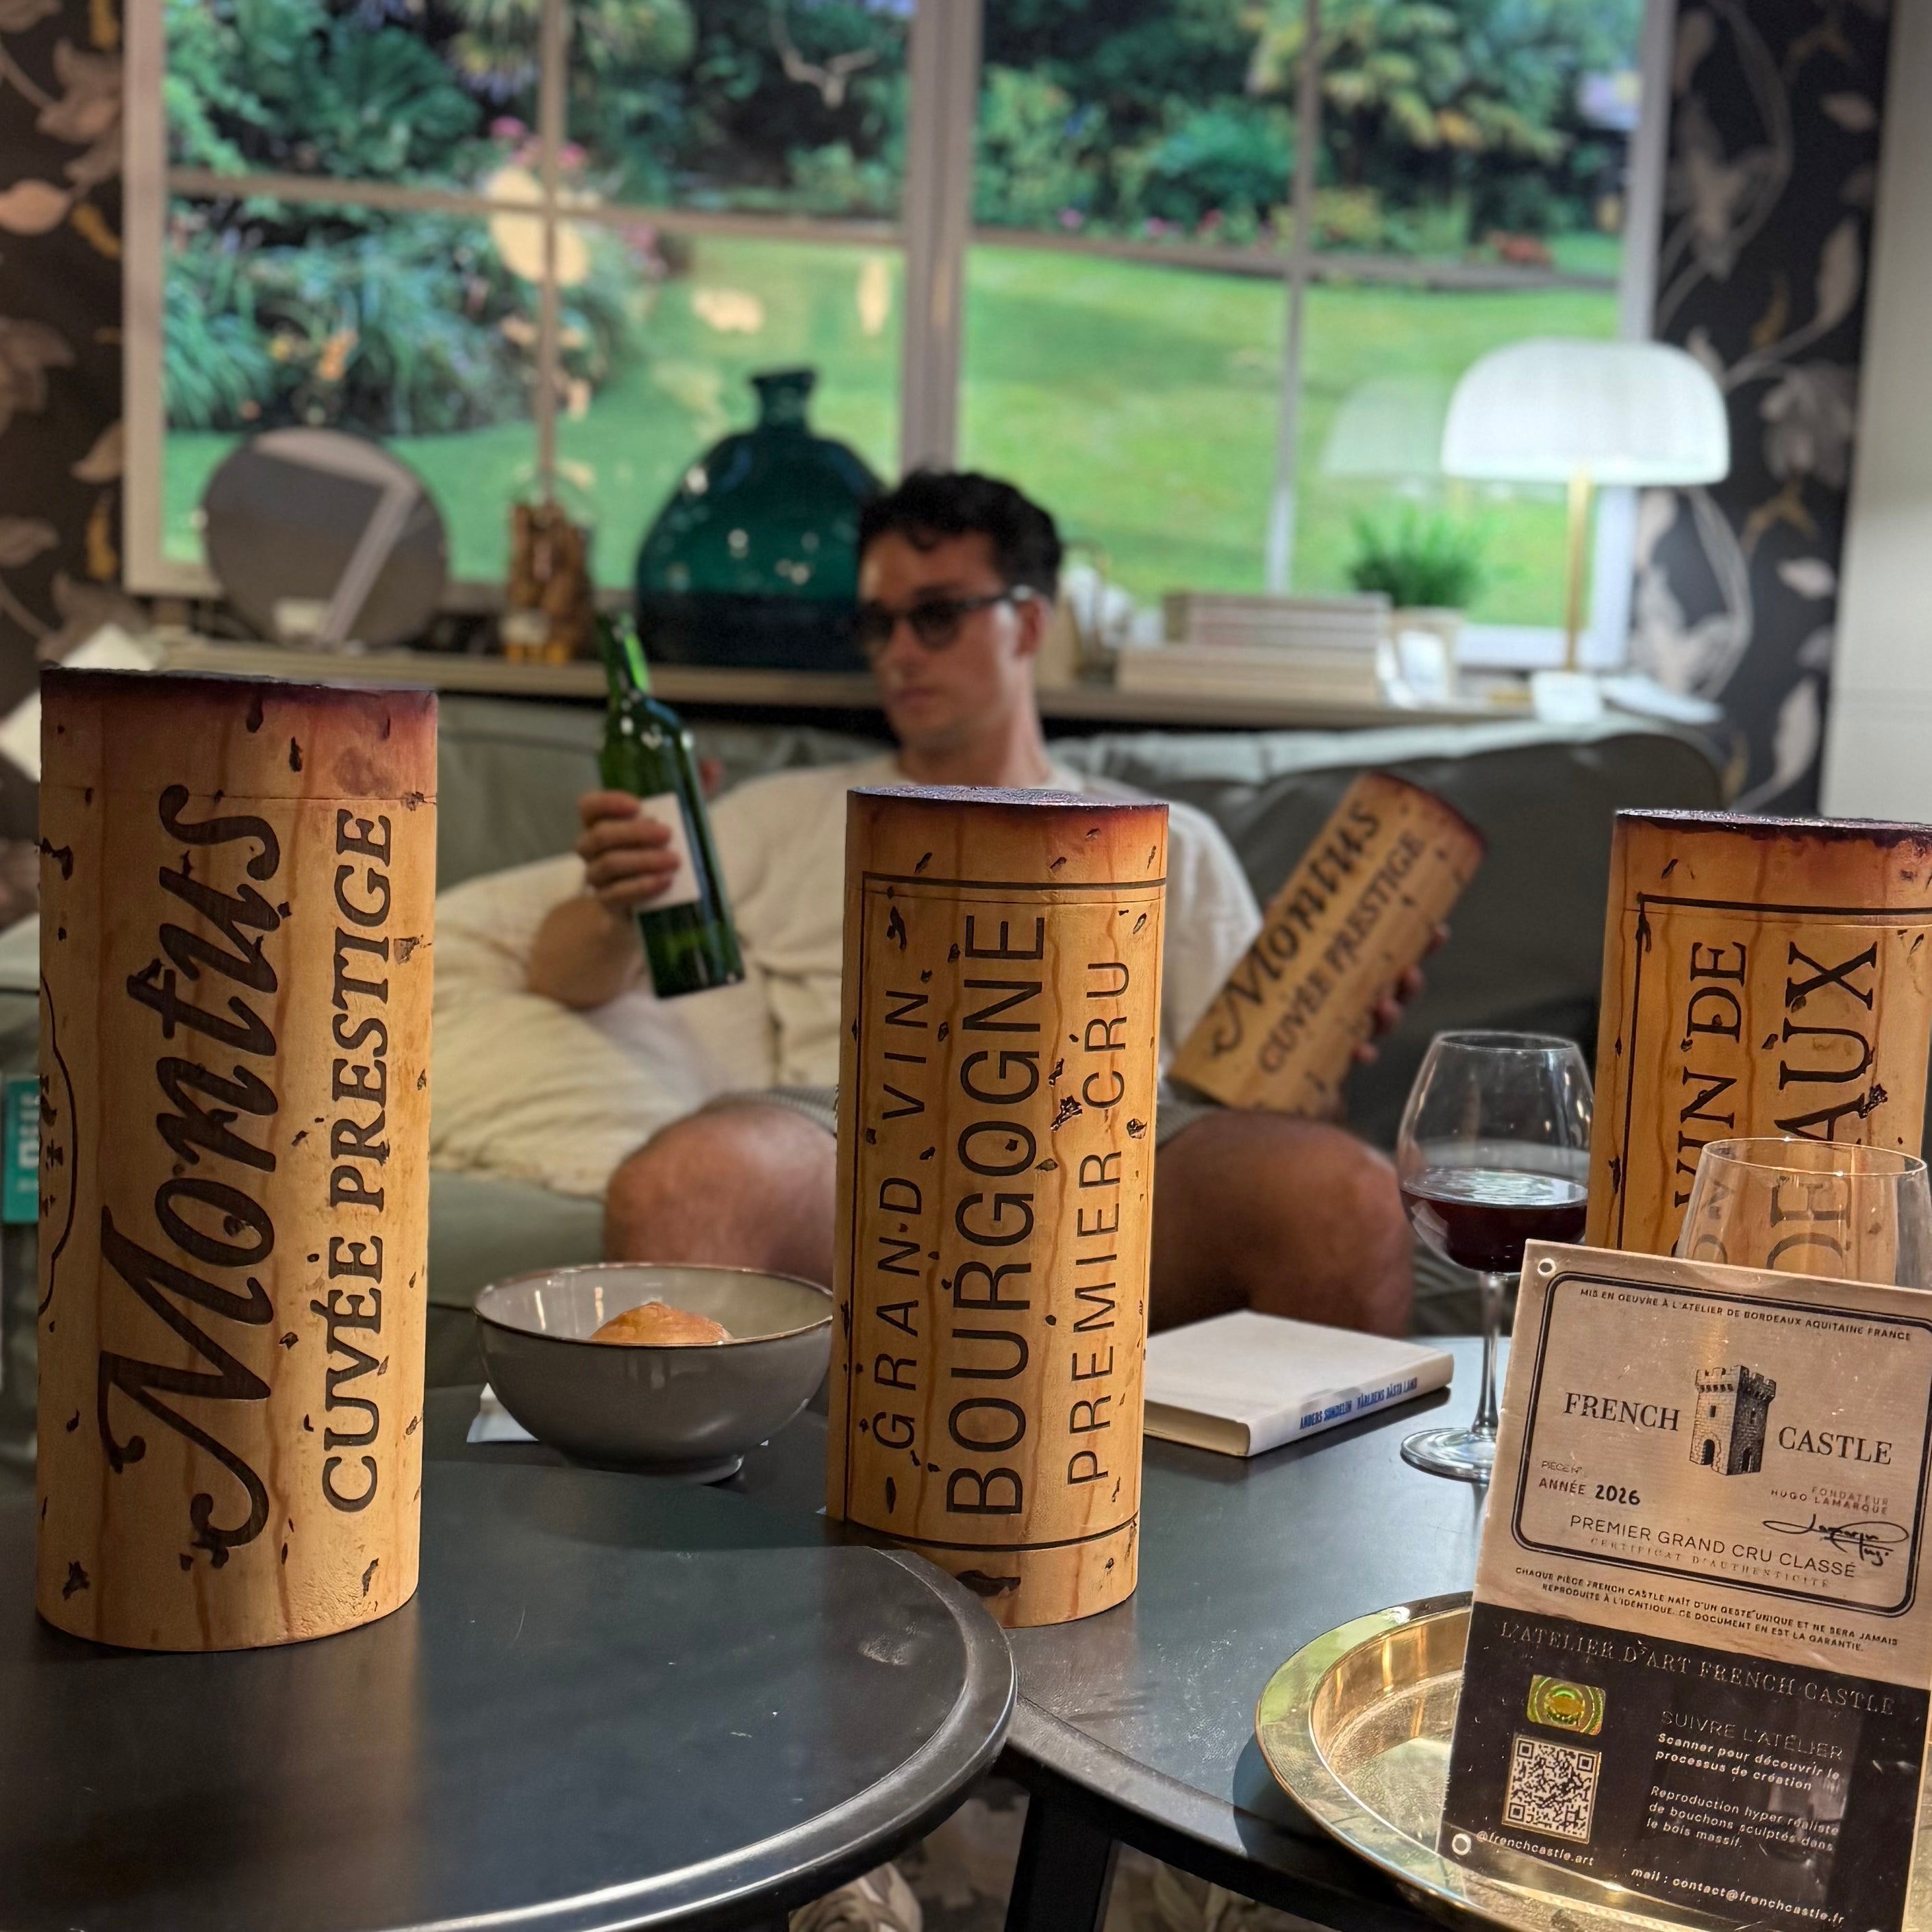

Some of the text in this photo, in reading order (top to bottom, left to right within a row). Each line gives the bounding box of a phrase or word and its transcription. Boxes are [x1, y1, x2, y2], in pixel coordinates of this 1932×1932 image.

[1686, 941, 1746, 1042] DE
[97, 785, 280, 1551] Montus
[310, 808, 392, 1512] CUVÉE PRESTIGE
[872, 991, 929, 1450] GRAND VIN
[946, 915, 1045, 1515] BOURGOGNE
[1067, 962, 1129, 1485] PREMIER CRU
[1602, 1292, 1614, 1300] EN
[1618, 1294, 1657, 1305] OEUVRE
[1672, 1302, 1722, 1315] L'ATELIER
[1727, 1309, 1740, 1317] DE
[1744, 1312, 1801, 1325] BORDEAUX
[1806, 1320, 1863, 1334] AQUITAINE
[1868, 1328, 1911, 1340] FRANCE
[1564, 1392, 1681, 1431] FRENCH
[1779, 1427, 1892, 1465] CASTLE
[1539, 1477, 1640, 1505] ANNÉE 2026
[1772, 1490, 1886, 1514] HUGO LAMARQUE
[1811, 1487, 1888, 1505] FONDATEUR
[1570, 1515, 1856, 1578] PREMIER GRAND CRU CLASSÉ
[1591, 1538, 1681, 1561] CERTIFICAT
[1516, 1567, 1553, 1581] CHAQUE
[1628, 1588, 1664, 1601] CASTLE
[1755, 1613, 1794, 1627] UNIQUE
[1797, 1620, 1809, 1629] ET
[1813, 1624, 1825, 1633] NE
[1830, 1627, 1855, 1638] SERA
[1859, 1633, 1898, 1646] JAMAIS
[1542, 1583, 1600, 1601] REPRODUITE
[1679, 1609, 1691, 1618] CE
[1695, 1612, 1751, 1630] DOCUMENT
[1755, 1624, 1768, 1633] EN
[1772, 1627, 1789, 1637] EST
[1793, 1631, 1805, 1640] LA
[1501, 1622, 1614, 1659] L'ATELIER
[1699, 1661, 1795, 1696] FRENCH
[1805, 1682, 1895, 1715] CASTLE
[1661, 1711, 1736, 1738] SUIVRE
[1655, 1751, 1812, 1790] processus de création
[1657, 1733, 1840, 1780] Scanner pour découvrir le
[1646, 1818, 1657, 1829] le
[1663, 1822, 1690, 1836] bois
[1649, 1803, 1833, 1851] de bouchons sculptés dans
[1651, 1786, 1740, 1814] Reproduction
[1744, 1807, 1783, 1823] hyper
[1477, 1831, 1594, 1866] @frenchcastle.art
[1631, 1868, 1660, 1882] mail
[1673, 1878, 1844, 1924] contact@frenchcastle.fr
